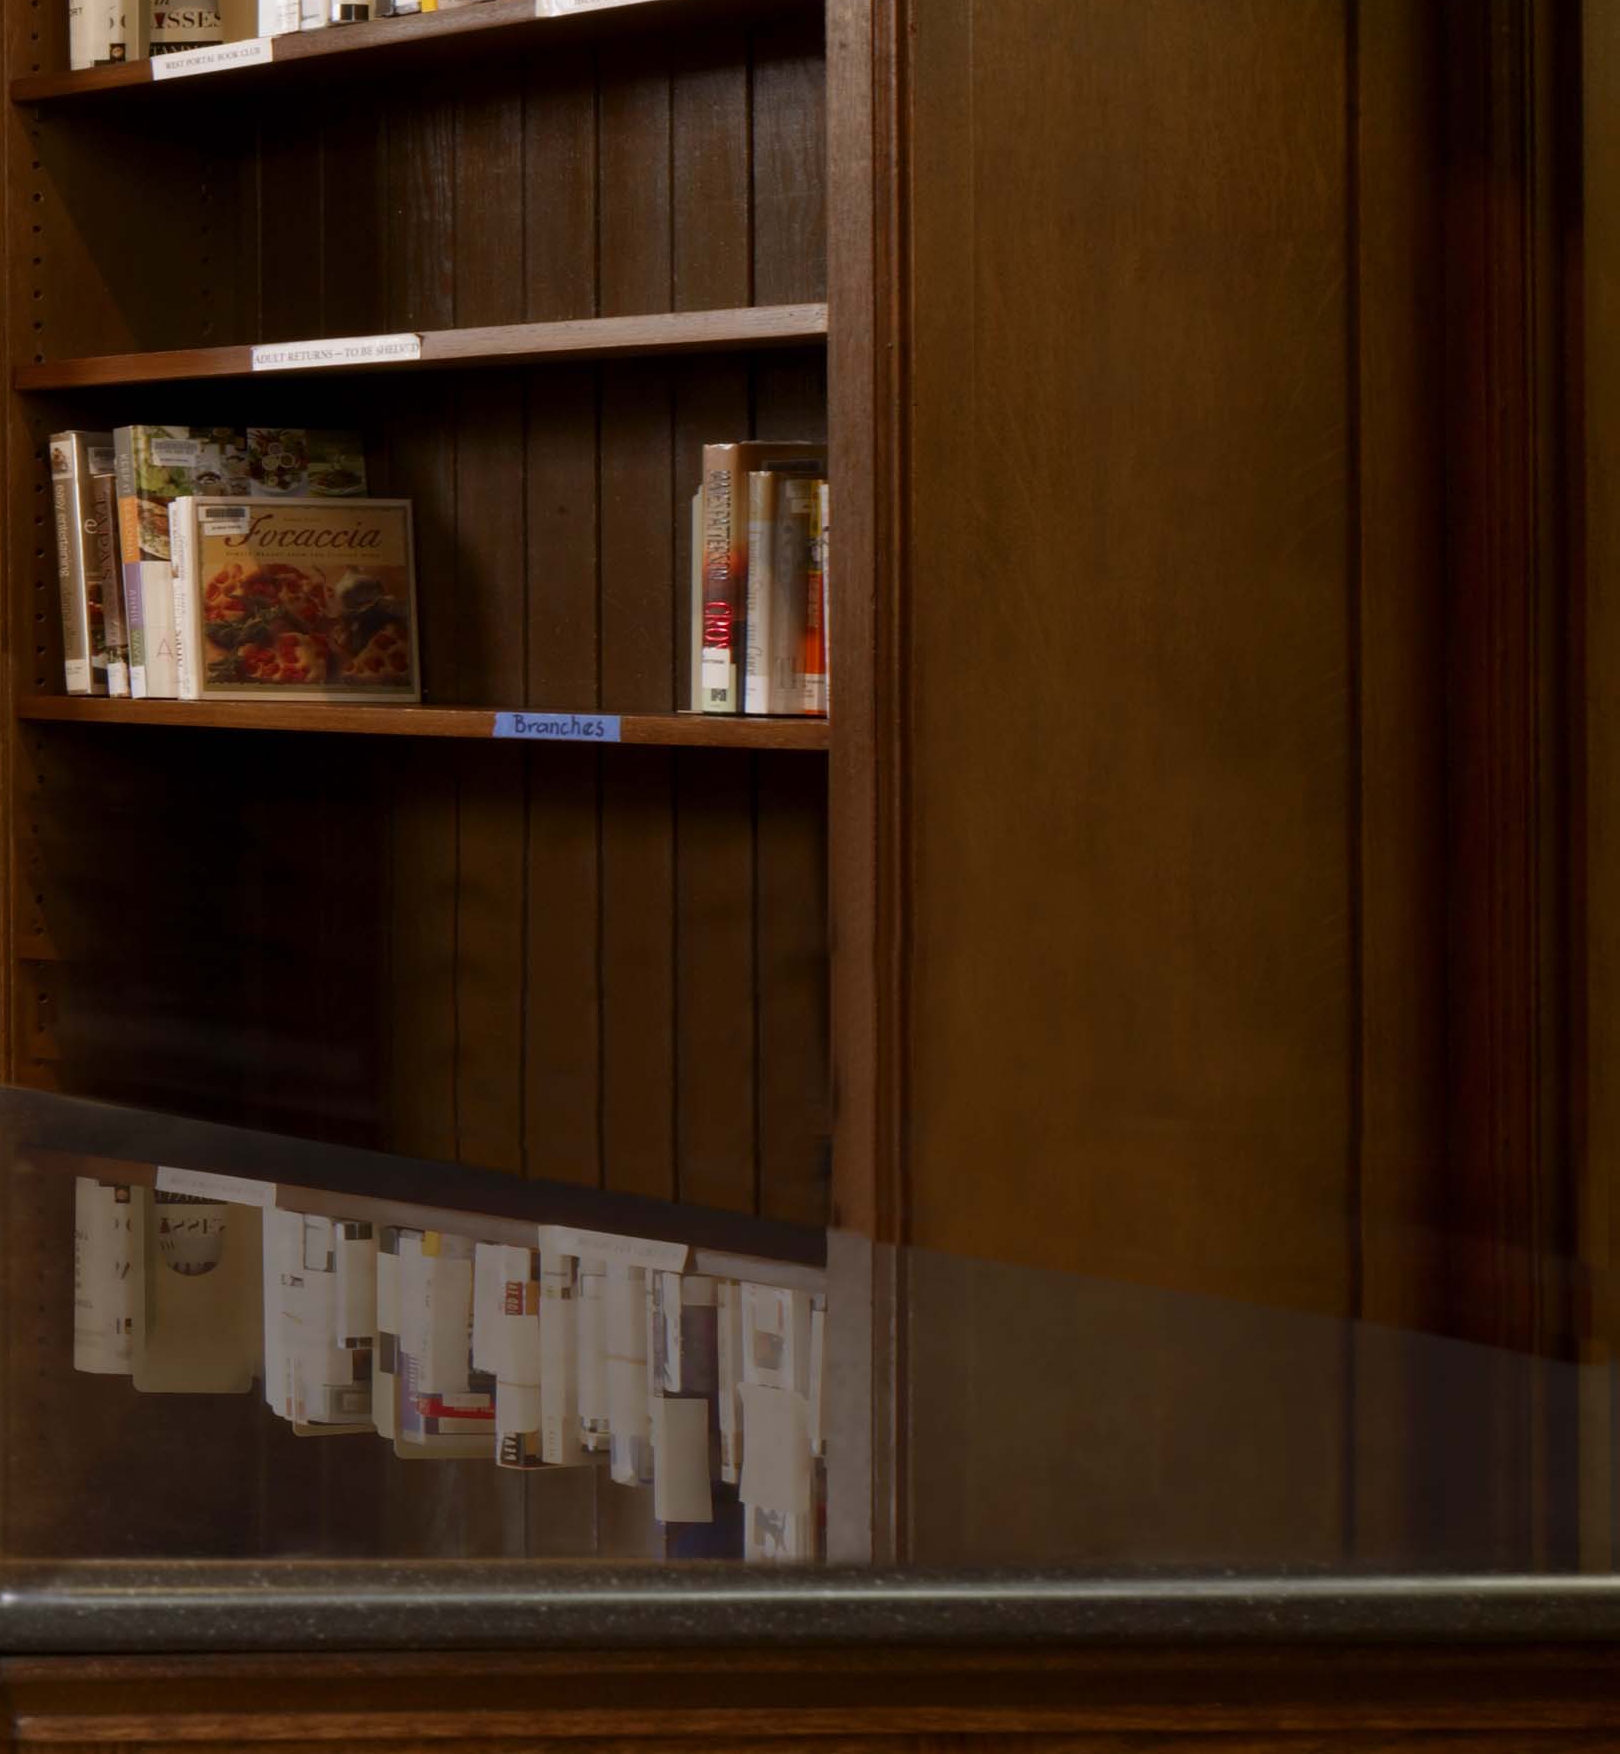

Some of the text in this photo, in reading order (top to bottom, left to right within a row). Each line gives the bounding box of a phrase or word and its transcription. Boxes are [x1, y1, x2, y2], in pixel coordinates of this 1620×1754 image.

[254, 351, 286, 365] ADULT
[287, 349, 334, 362] RETURNS
[344, 347, 359, 358] TO
[361, 345, 374, 357] BE
[55, 484, 71, 578] easy entertaining
[224, 513, 381, 549] Focaccia
[706, 510, 731, 580] PATTERSON
[704, 601, 730, 648] CRO
[513, 713, 605, 738] Branches
